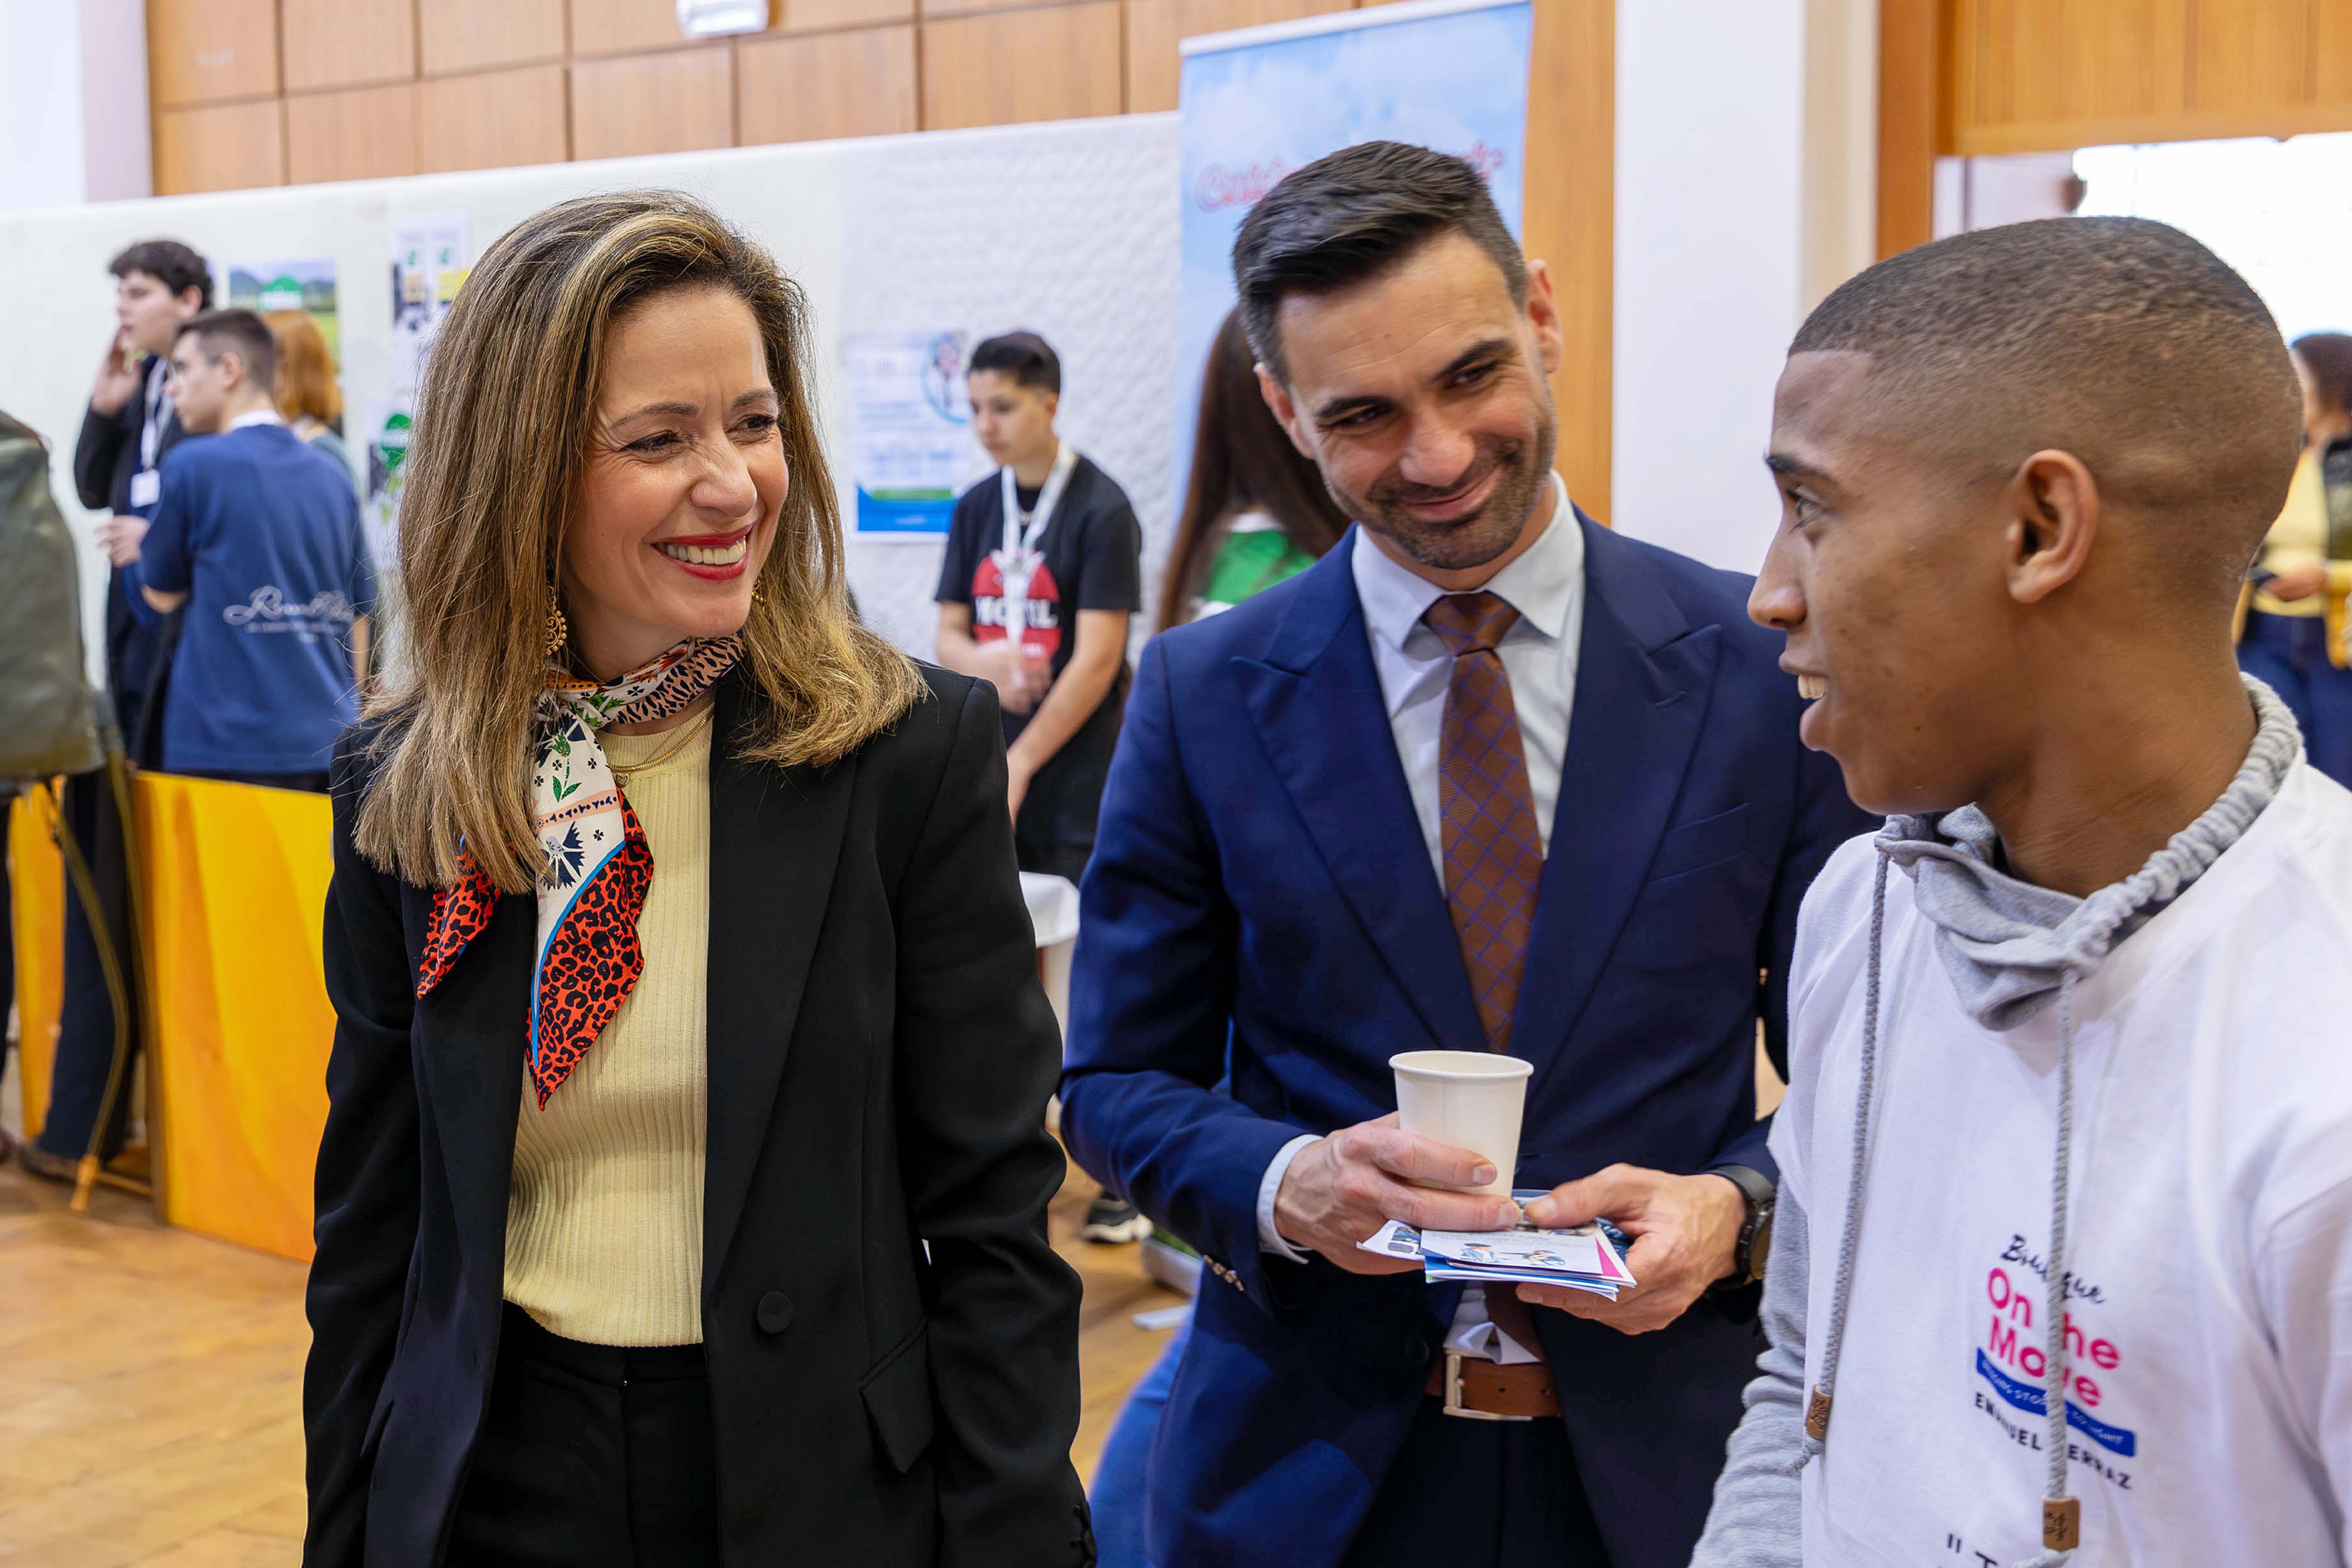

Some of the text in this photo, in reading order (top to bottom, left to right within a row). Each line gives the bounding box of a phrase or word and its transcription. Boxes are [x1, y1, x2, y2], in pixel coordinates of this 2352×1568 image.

[1988, 1267, 2121, 1371] On he
[1975, 1391, 2042, 1451] EMUEL
